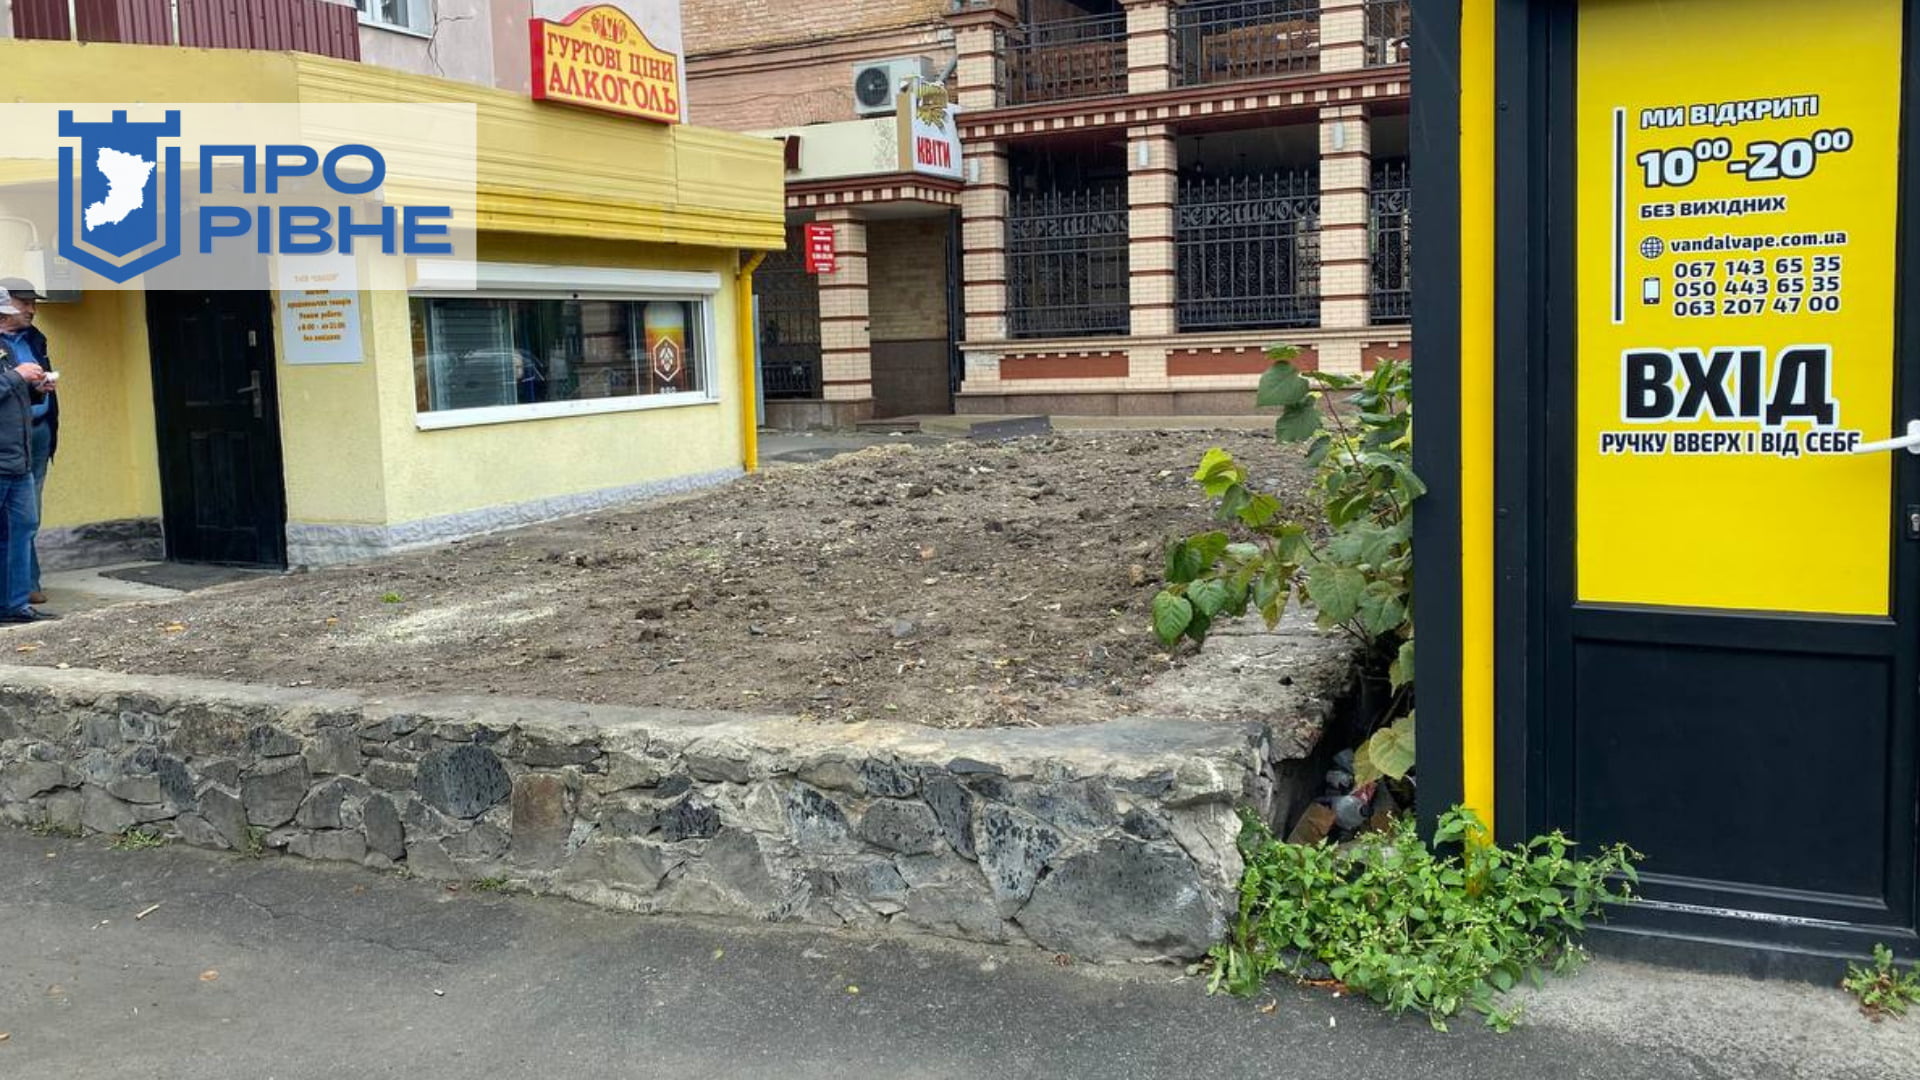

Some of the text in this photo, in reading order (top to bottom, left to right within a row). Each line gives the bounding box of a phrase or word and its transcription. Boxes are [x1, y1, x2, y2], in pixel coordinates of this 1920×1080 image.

[547, 31, 674, 83] ГУРТОВІ ЦІНИ
[549, 61, 676, 115] АЛКОГОЛЬ
[1641, 95, 1819, 129] МИ ВІДКРИТІ
[916, 135, 951, 169] КВІТИ
[1641, 197, 1786, 219] БЕЗ ВИХІДНИХ
[1671, 232, 1847, 252] vandalvape.com.ua
[1674, 256, 1841, 278] 067 143 65 35
[1674, 276, 1840, 297] 050 443 65 35
[1674, 296, 1840, 316] 063 207 47 00
[1625, 348, 1835, 426] ВХІД
[1602, 432, 1667, 453] РУЧКУ
[1674, 432, 1740, 452] ВВЕРХ
[1747, 433, 1754, 452] І
[1761, 432, 1799, 456] ВІД
